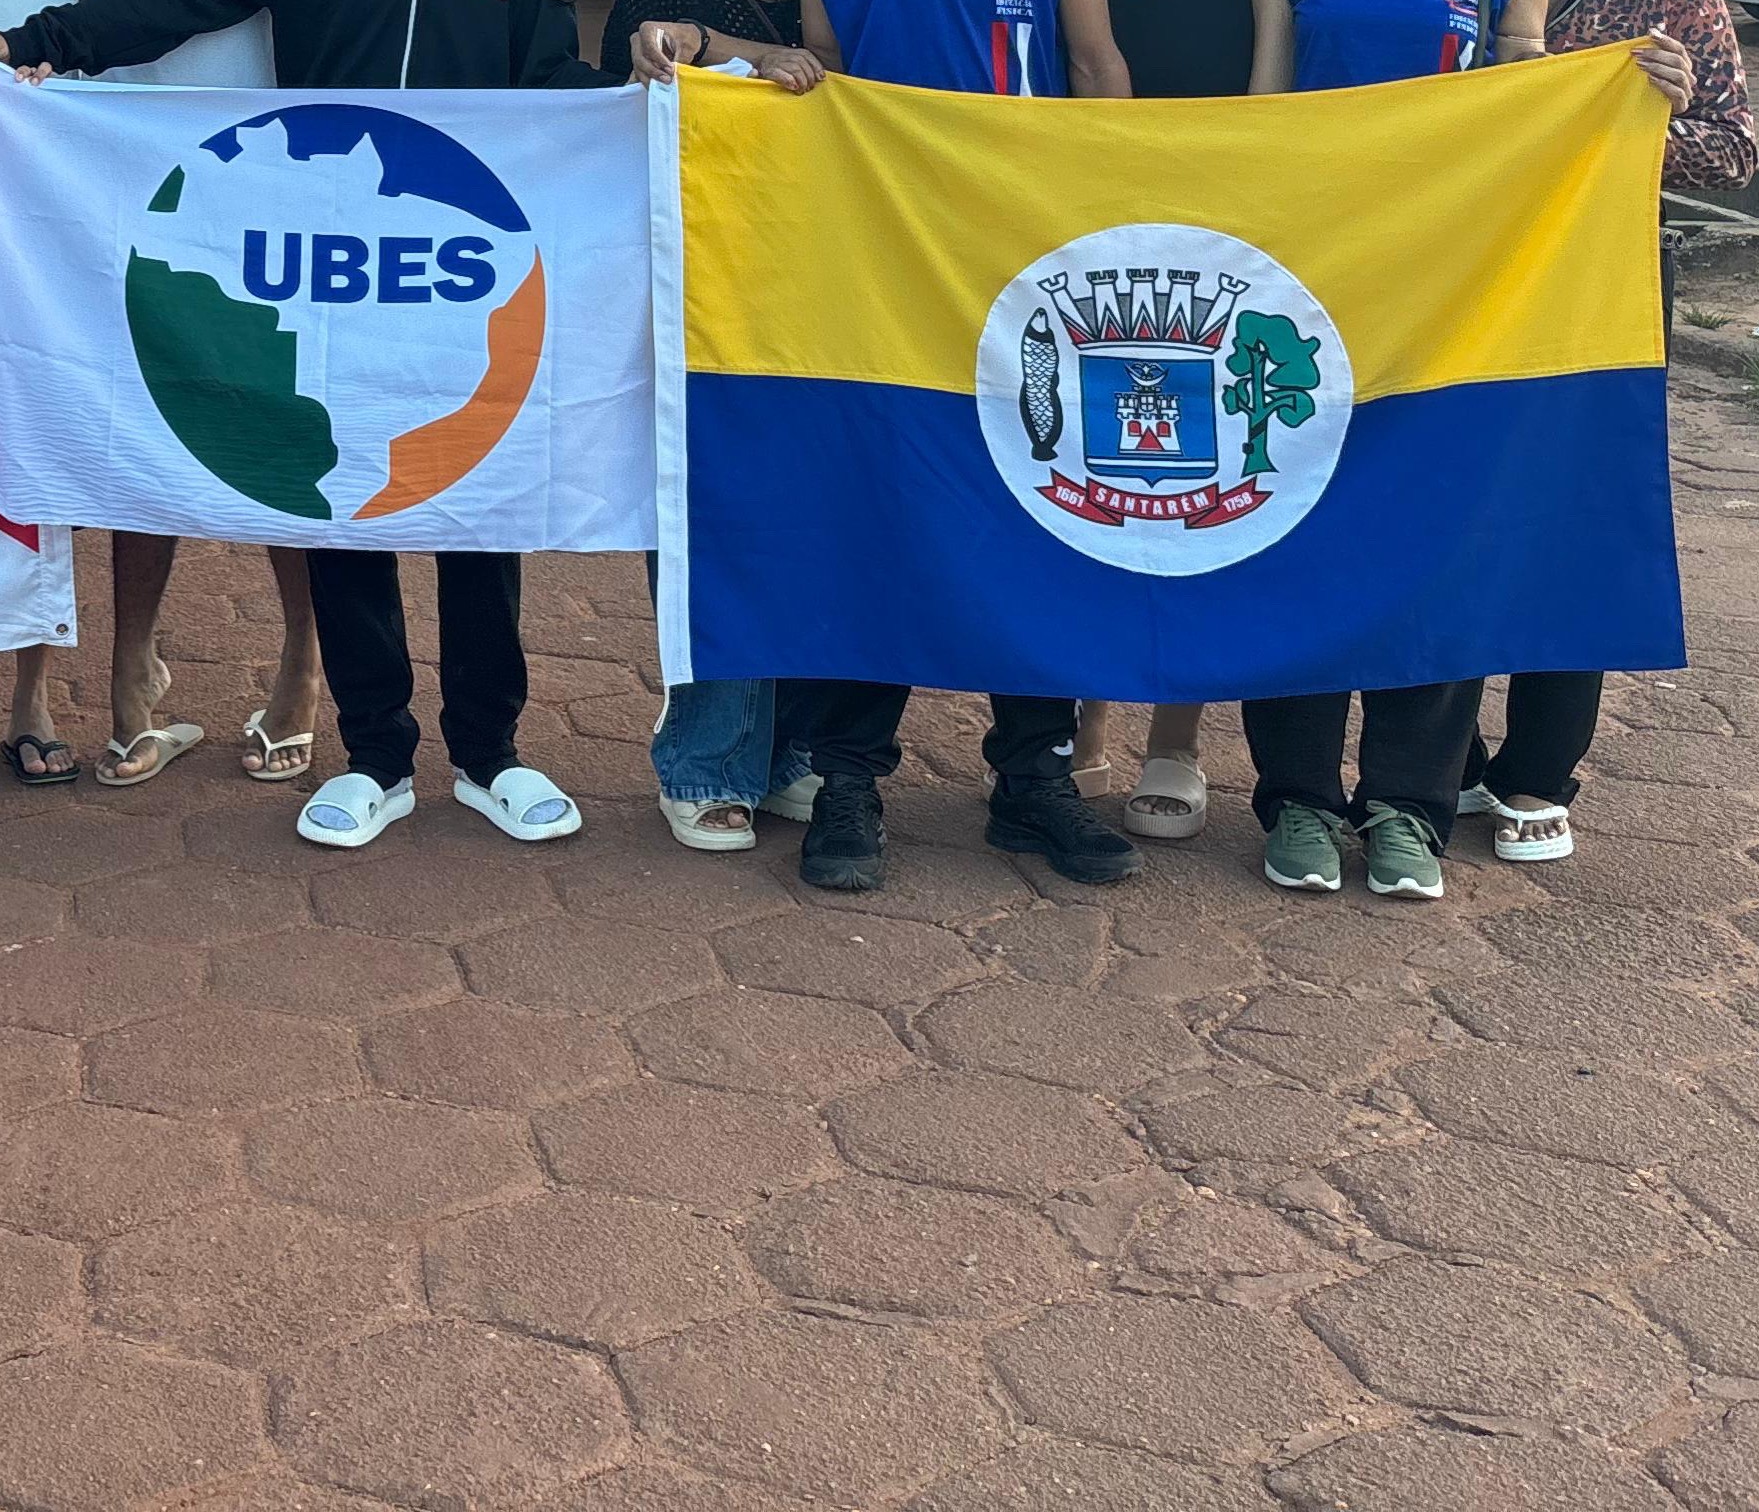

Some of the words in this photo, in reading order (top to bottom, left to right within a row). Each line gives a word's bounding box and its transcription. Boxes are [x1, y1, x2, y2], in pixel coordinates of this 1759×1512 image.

[243, 230, 495, 303] UBES
[1055, 485, 1085, 508] 1661
[1095, 487, 1209, 517] SANTARÉM
[1222, 491, 1253, 513] 1758
